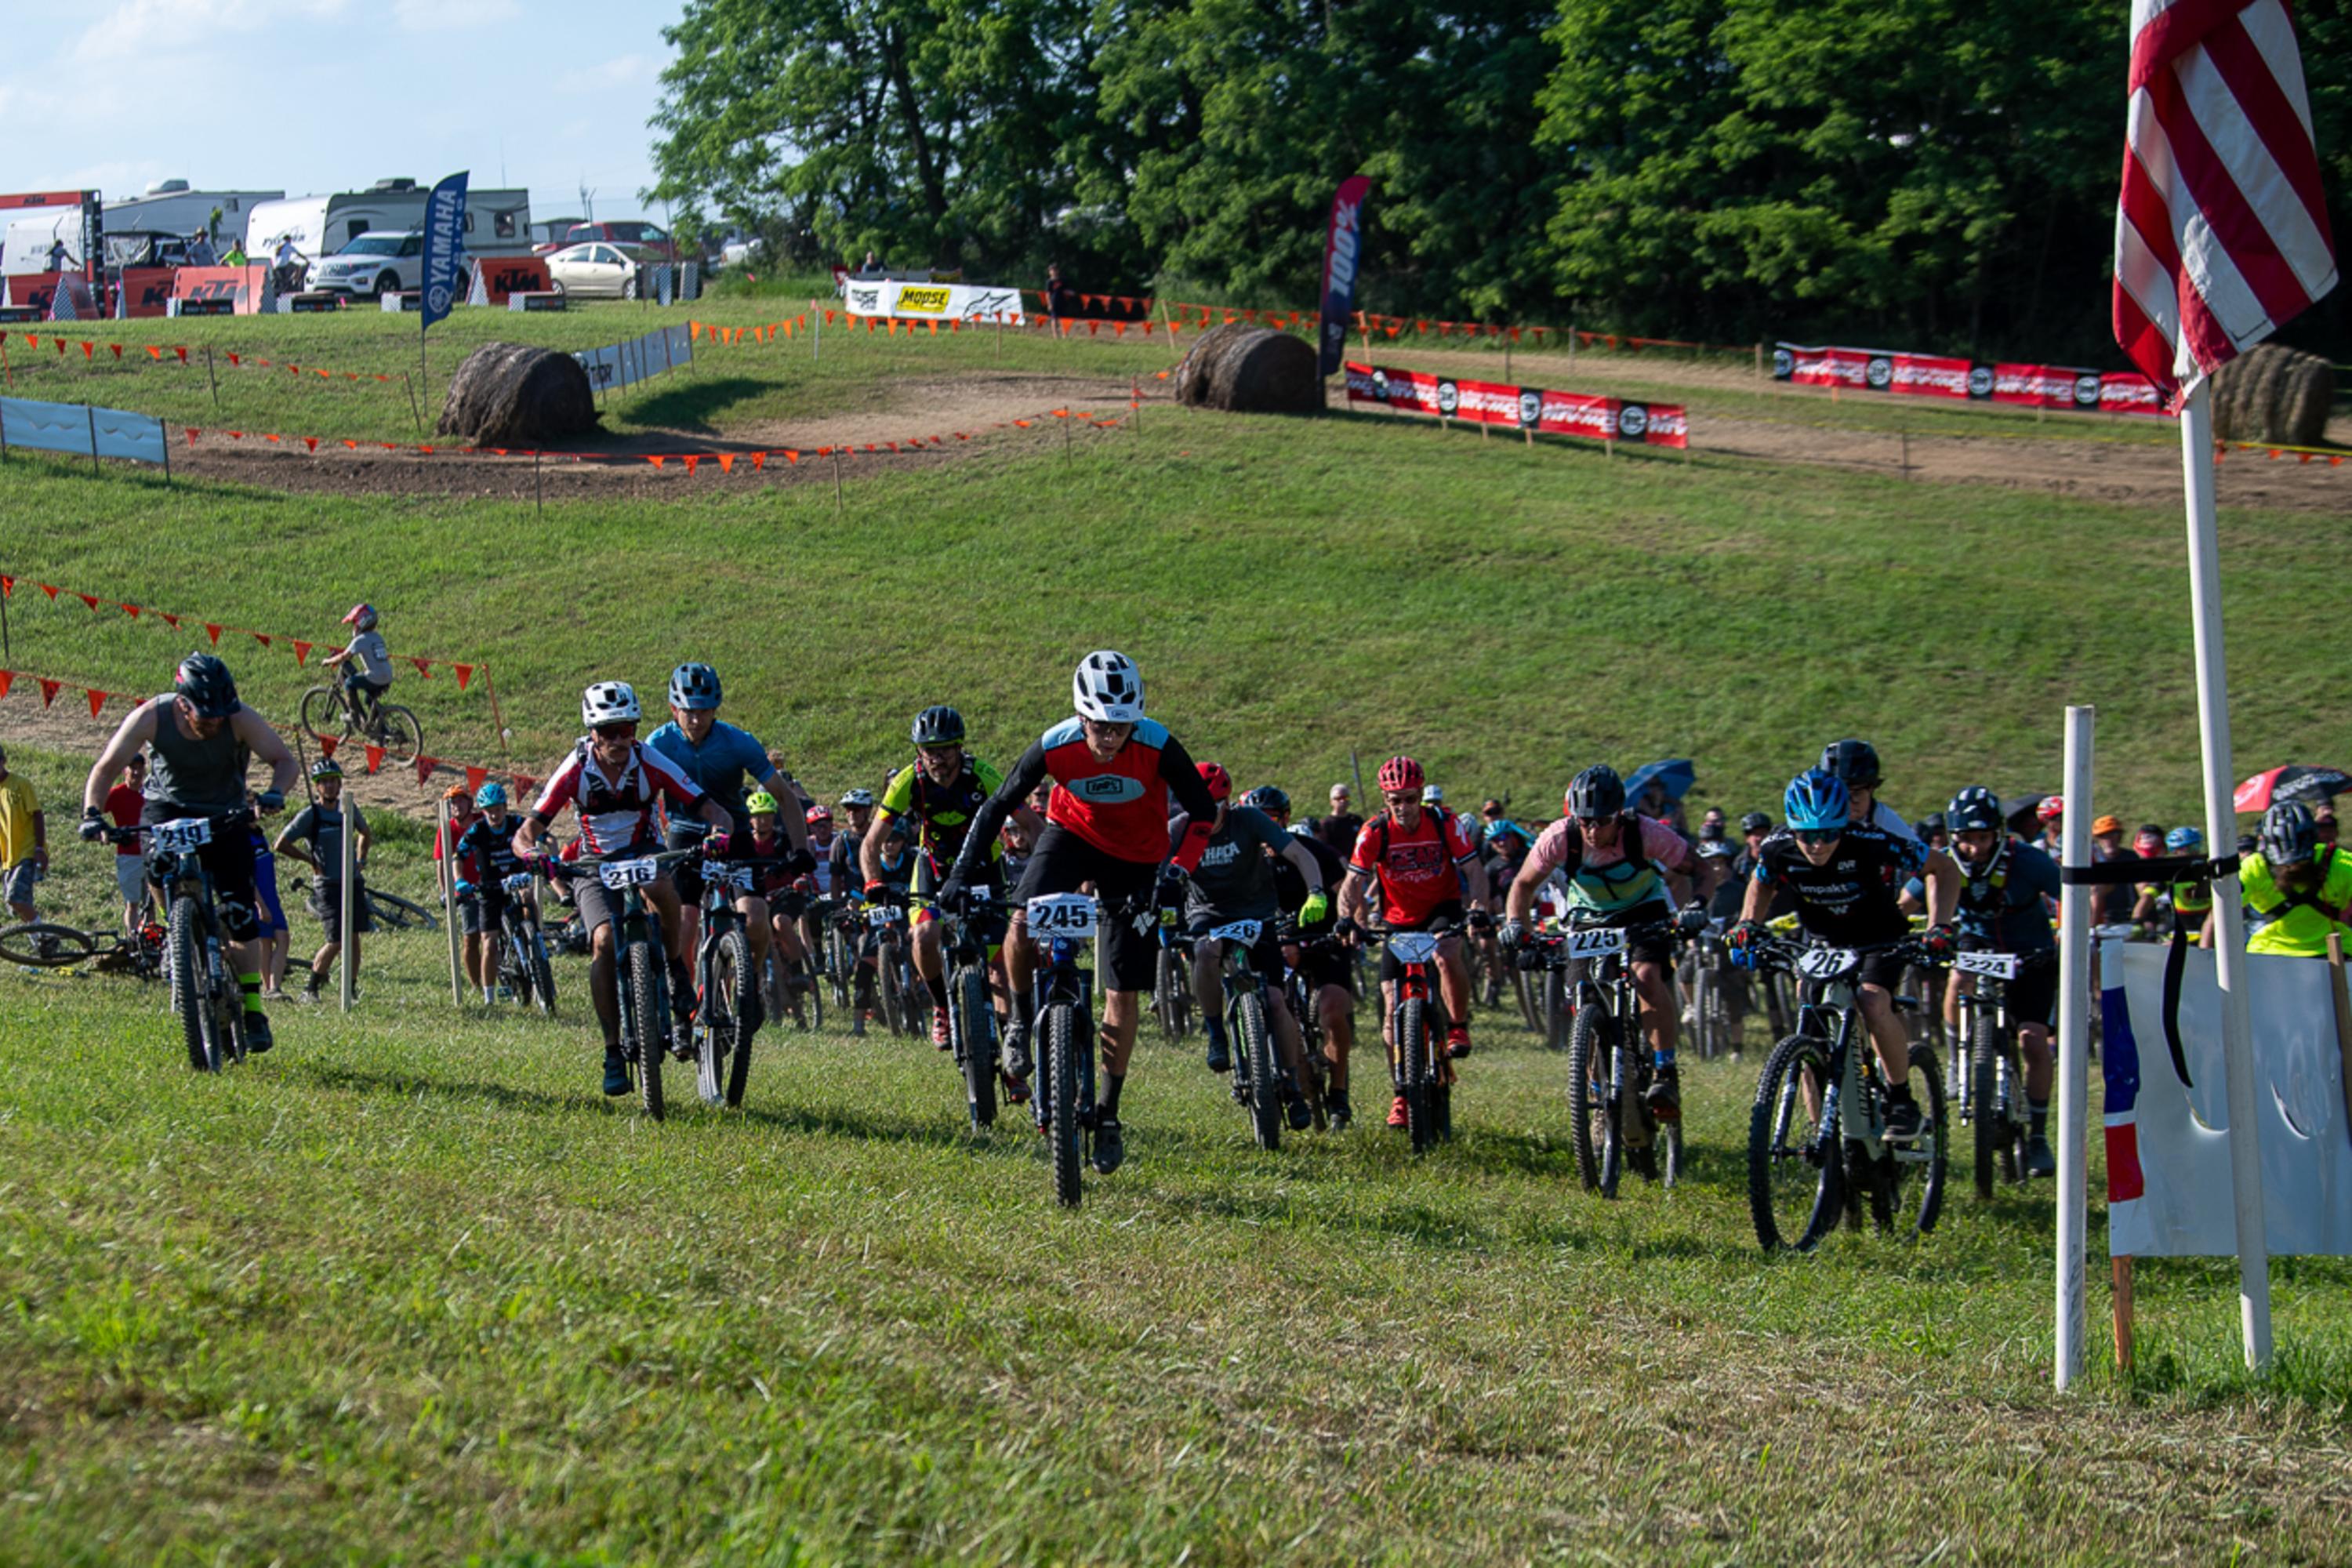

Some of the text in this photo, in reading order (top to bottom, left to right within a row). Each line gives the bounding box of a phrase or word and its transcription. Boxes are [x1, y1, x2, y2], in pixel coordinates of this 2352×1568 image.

[430, 189, 458, 284] YAMAHA
[1329, 198, 1359, 298] 100%
[494, 268, 541, 294] KTM
[901, 290, 948, 305] MOOSE
[608, 867, 652, 887] 216
[1035, 905, 1088, 929] 245
[1573, 930, 1619, 951] 225
[1809, 951, 1845, 975] 26
[1962, 958, 2009, 974] 224
